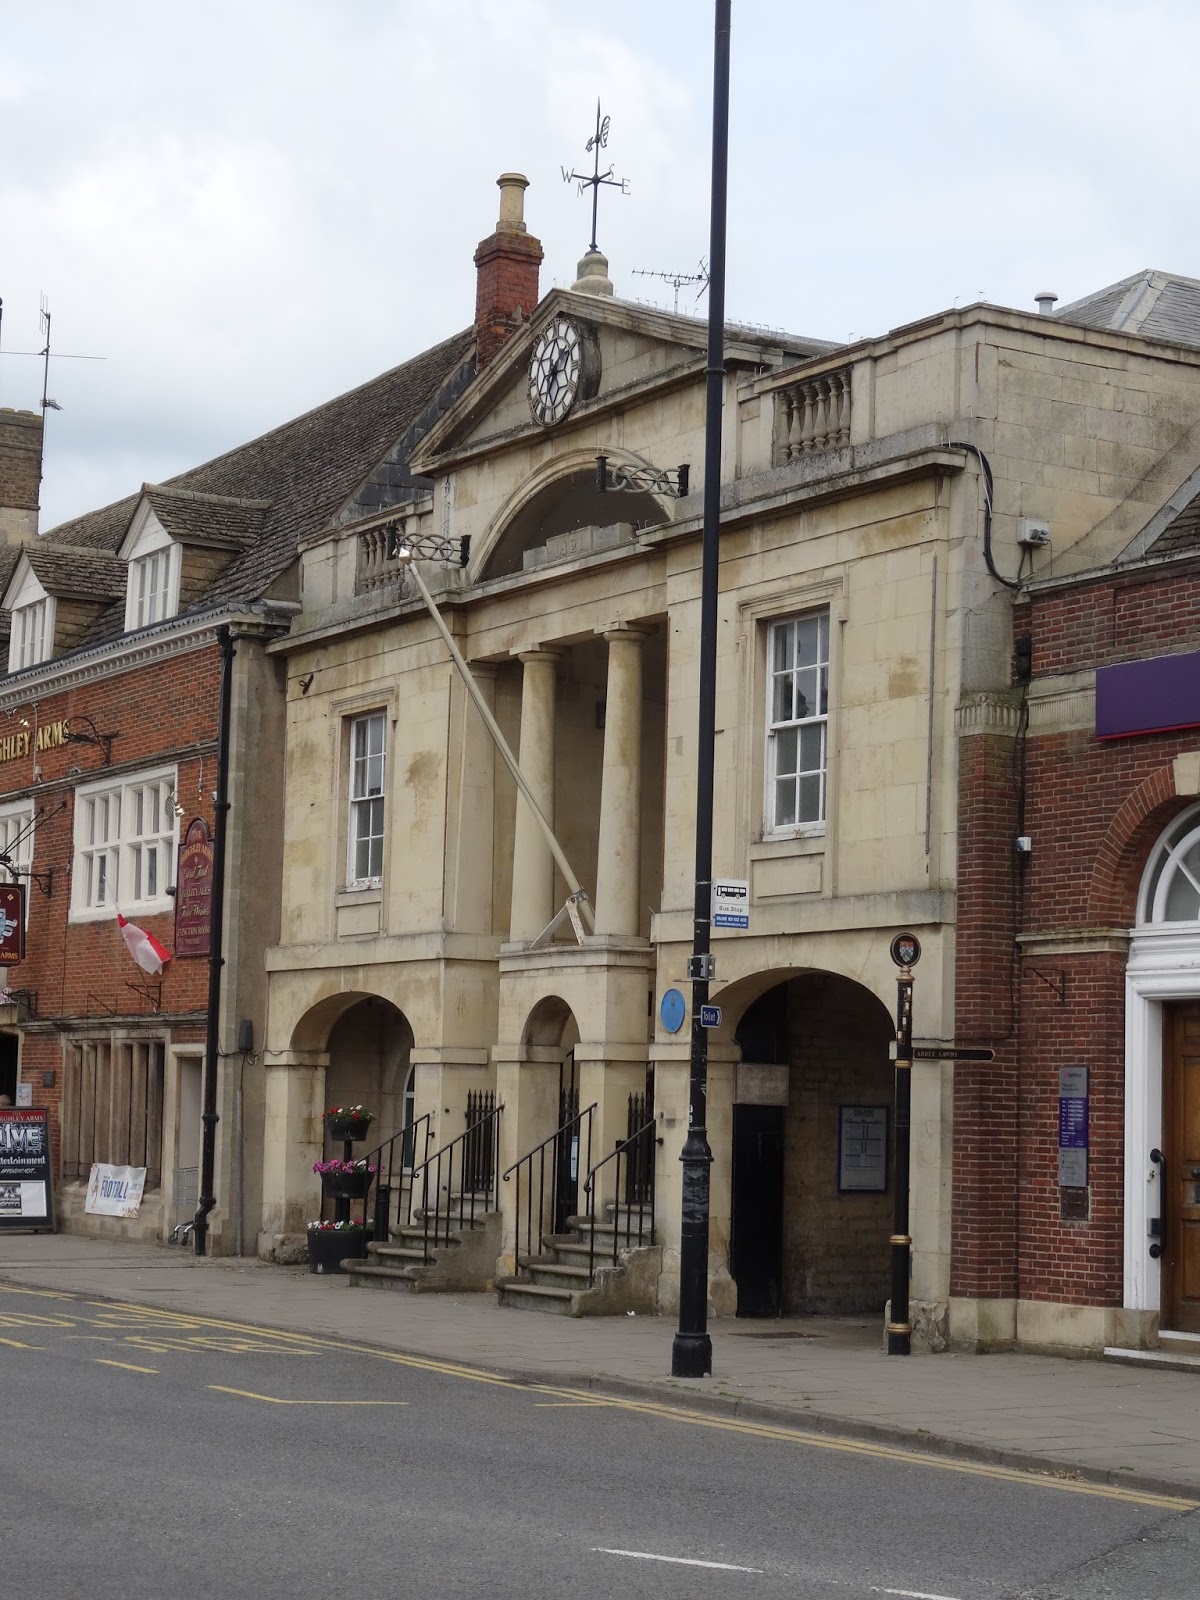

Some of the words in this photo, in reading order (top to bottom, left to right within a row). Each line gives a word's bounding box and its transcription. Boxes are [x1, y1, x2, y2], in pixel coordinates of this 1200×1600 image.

[560, 165, 574, 183] W
[621, 178, 631, 195] E
[36, 719, 69, 751] ARMS
[730, 906, 743, 914] Stop
[703, 1011, 715, 1021] Toilet
[100, 1179, 129, 1199] FOOTBALL
